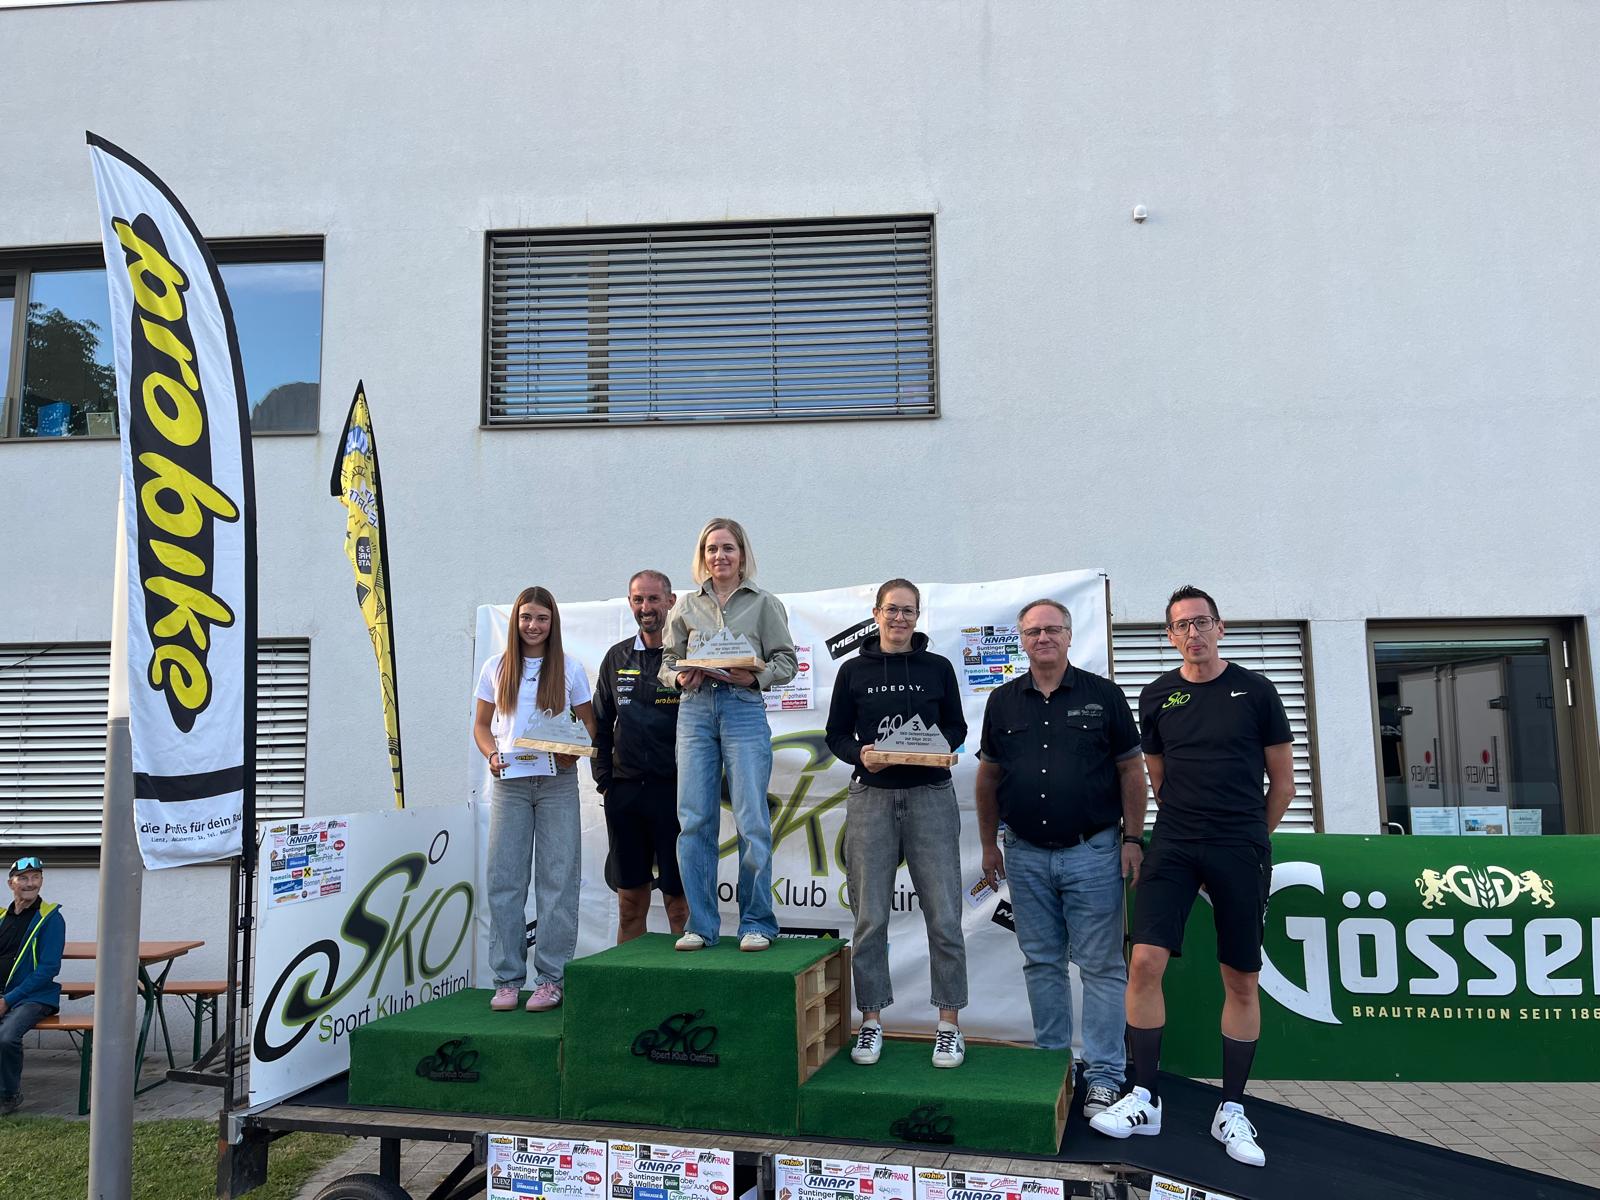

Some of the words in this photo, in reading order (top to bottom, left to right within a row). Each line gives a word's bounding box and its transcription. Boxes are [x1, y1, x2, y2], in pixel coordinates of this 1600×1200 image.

[831, 622, 880, 653] MERID
[984, 635, 1019, 644] KNAPP
[912, 721, 921, 731] 3.
[140, 822, 160, 834] die
[190, 821, 206, 833] für
[207, 817, 231, 830] dein
[289, 833, 318, 845] KNAPP
[1256, 861, 1600, 1024] Gösse
[318, 1004, 371, 1044] Sport
[377, 990, 414, 1019] Klub
[420, 969, 470, 1005] Osttirol
[1352, 1005, 1511, 1020] BRAUTRADITION
[1519, 1007, 1563, 1020] SEIT
[517, 1154, 556, 1165] KNAPP
[507, 1164, 538, 1174] Suntinger
[638, 1161, 681, 1173] KNAPP
[513, 1172, 538, 1180] Wallner
[628, 1172, 663, 1182] Suntinger
[635, 1180, 662, 1189] Wallner
[808, 1176, 855, 1189] KNAPP
[544, 1183, 583, 1194] GreenPrint
[798, 1188, 835, 1200] Suntinger
[951, 1190, 1002, 1200] KNAPP
